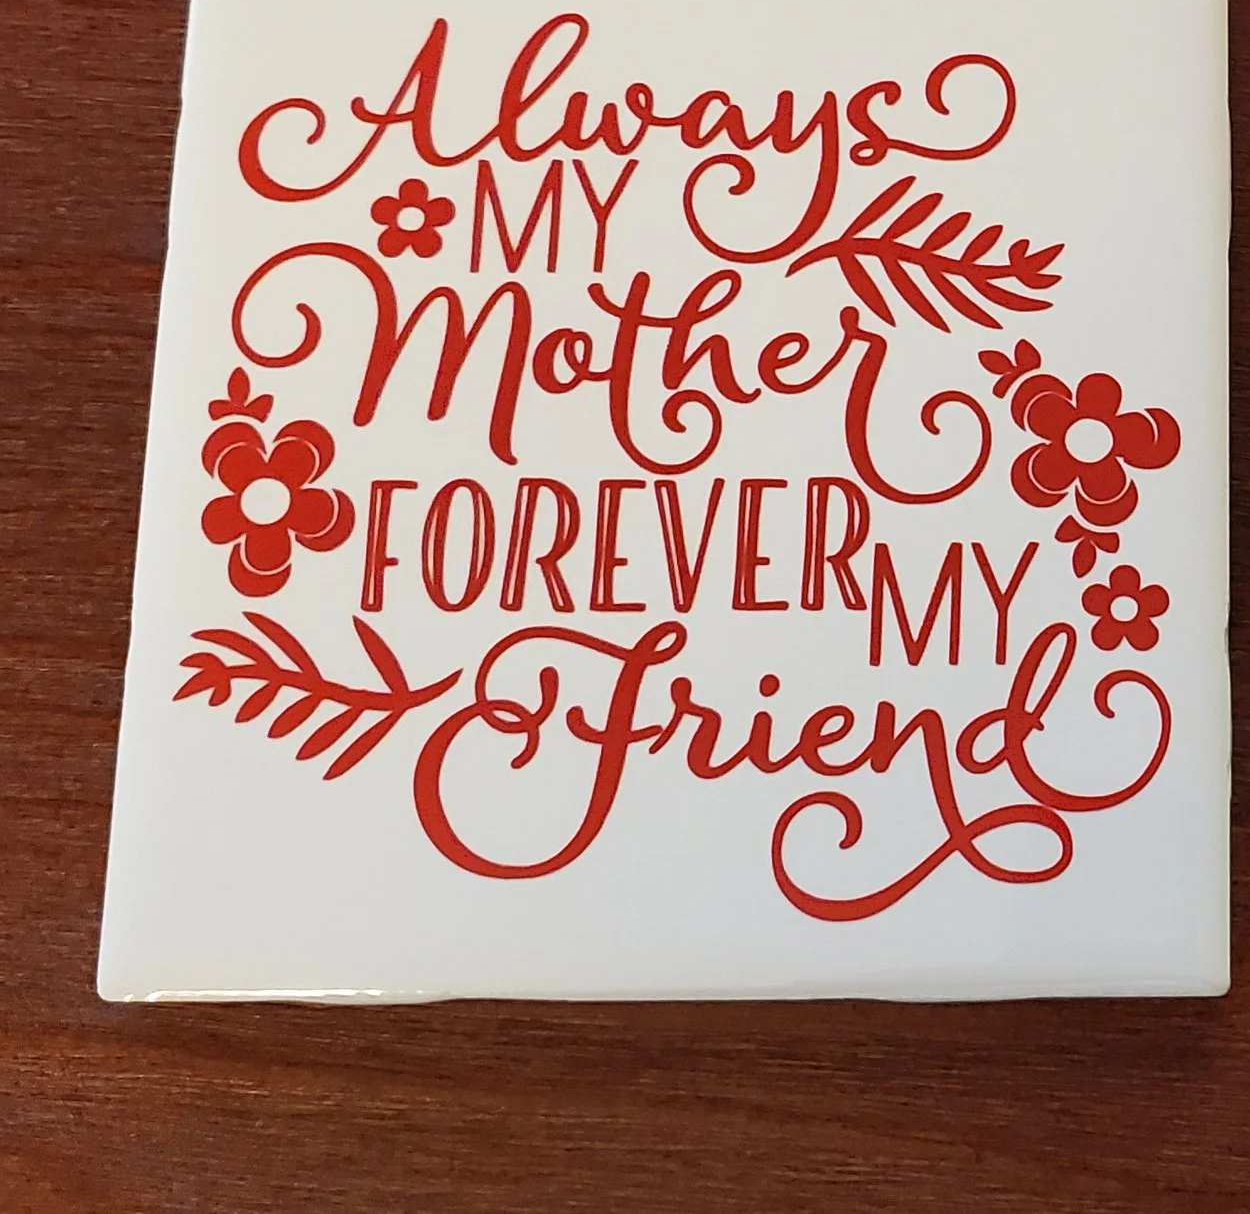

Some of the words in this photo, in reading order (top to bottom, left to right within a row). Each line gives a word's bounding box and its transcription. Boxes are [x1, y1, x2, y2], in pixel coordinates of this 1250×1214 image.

[236, 12, 1017, 266] Always
[468, 158, 640, 275] MY
[230, 241, 993, 506] Mother
[359, 476, 871, 615] FOREVER
[868, 540, 1040, 668] MY
[412, 619, 1172, 923] Friend
